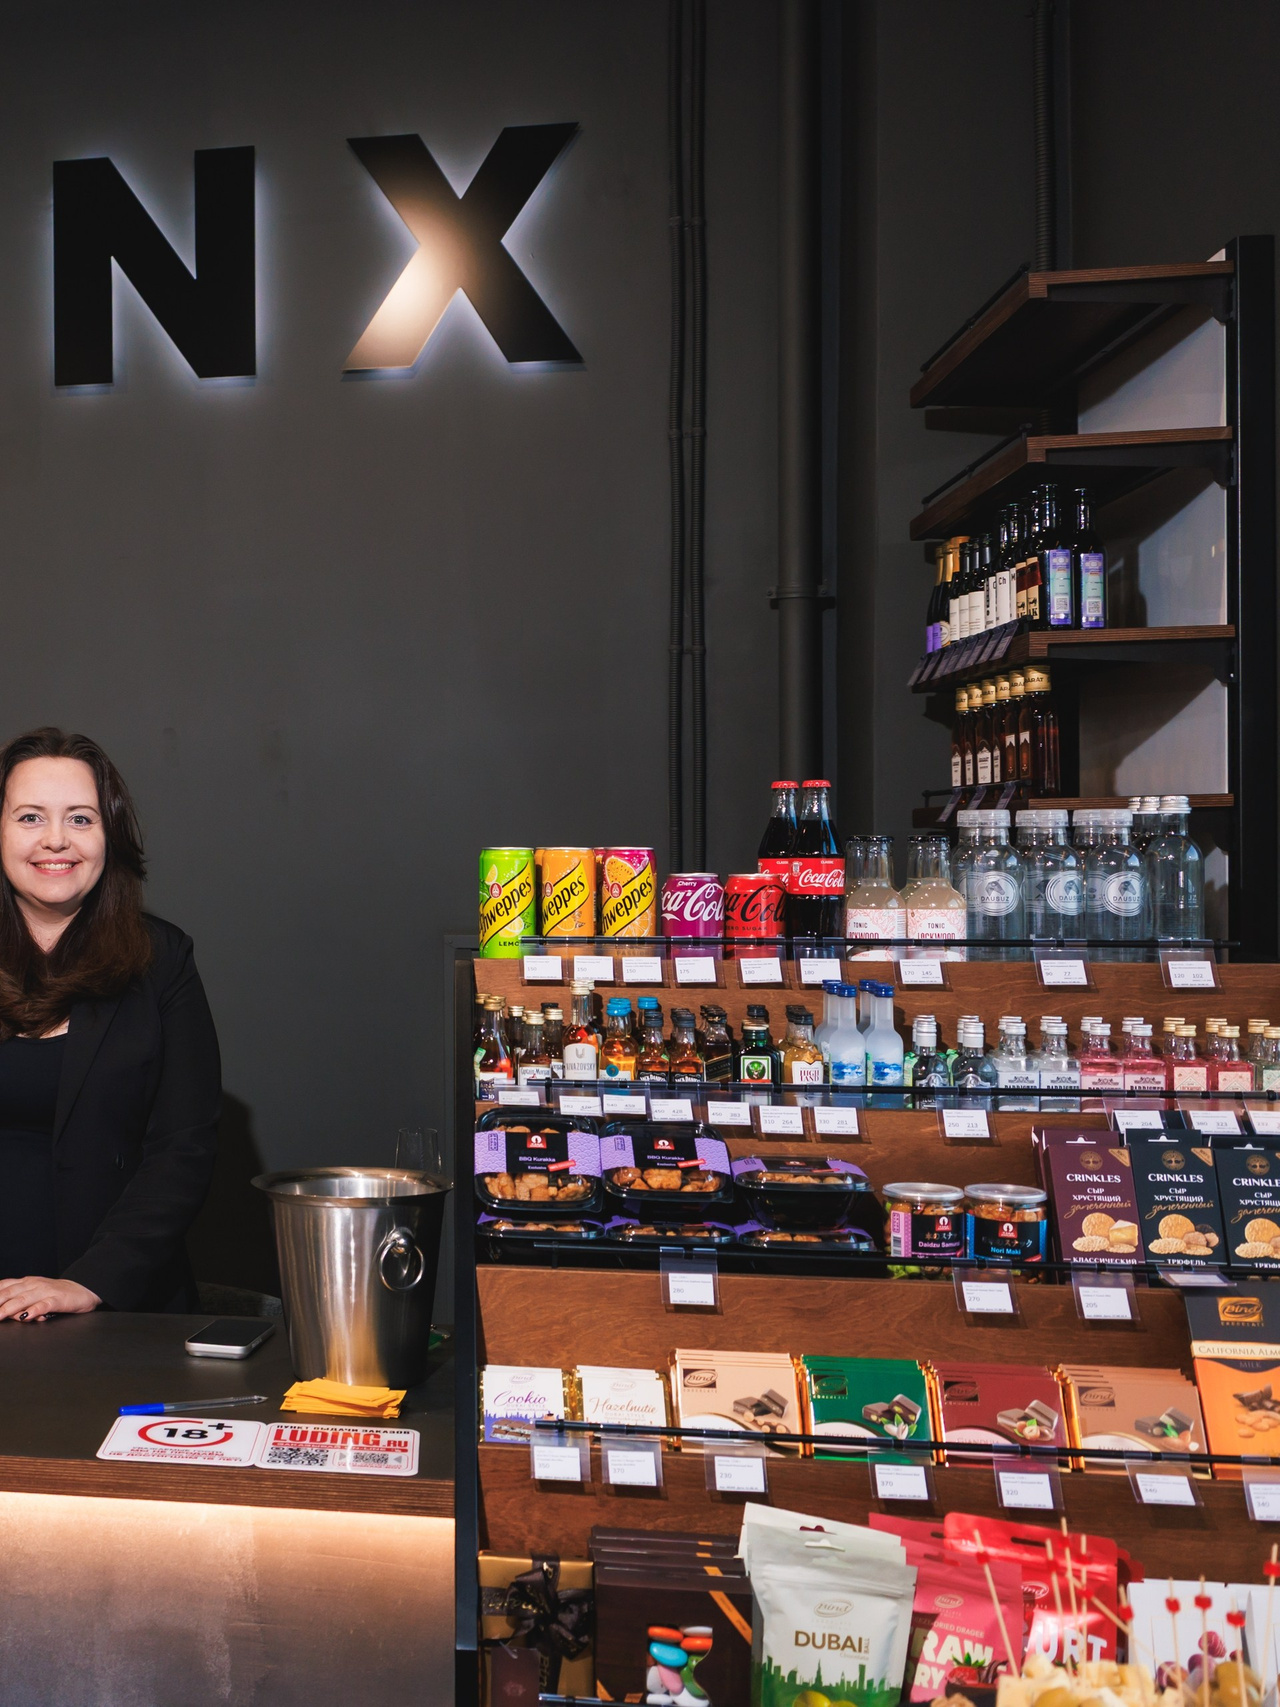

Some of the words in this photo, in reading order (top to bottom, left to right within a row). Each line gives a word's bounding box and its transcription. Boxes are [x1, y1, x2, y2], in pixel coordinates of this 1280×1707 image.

[677, 880, 697, 888] Cherry
[853, 921, 868, 929] TONIC
[927, 922, 946, 930] TONIC
[1066, 1173, 1122, 1183] CRINKLES
[1148, 1173, 1204, 1183] CRINKLES
[1072, 1194, 1122, 1203] ХРУСТЯЩИЙ
[1154, 1194, 1204, 1203] ХРУСТЯЩИЙ
[1063, 1200, 1132, 1219] запеченный
[1145, 1200, 1214, 1219] запеченный
[1072, 1256, 1137, 1265] КЛАССИЧЕСКИЙ
[1225, 1304, 1260, 1314] Bind
[1198, 1345, 1256, 1356] CALIFORNIA
[1239, 1361, 1262, 1369] MILK
[688, 1373, 714, 1382] Bind
[589, 1397, 658, 1414] Hazelnutie
[164, 1422, 233, 1439] 18+
[273, 1428, 409, 1448] LUDING.RU
[955, 1626, 985, 1638] DRAGEE
[794, 1630, 863, 1653] DUBAI
